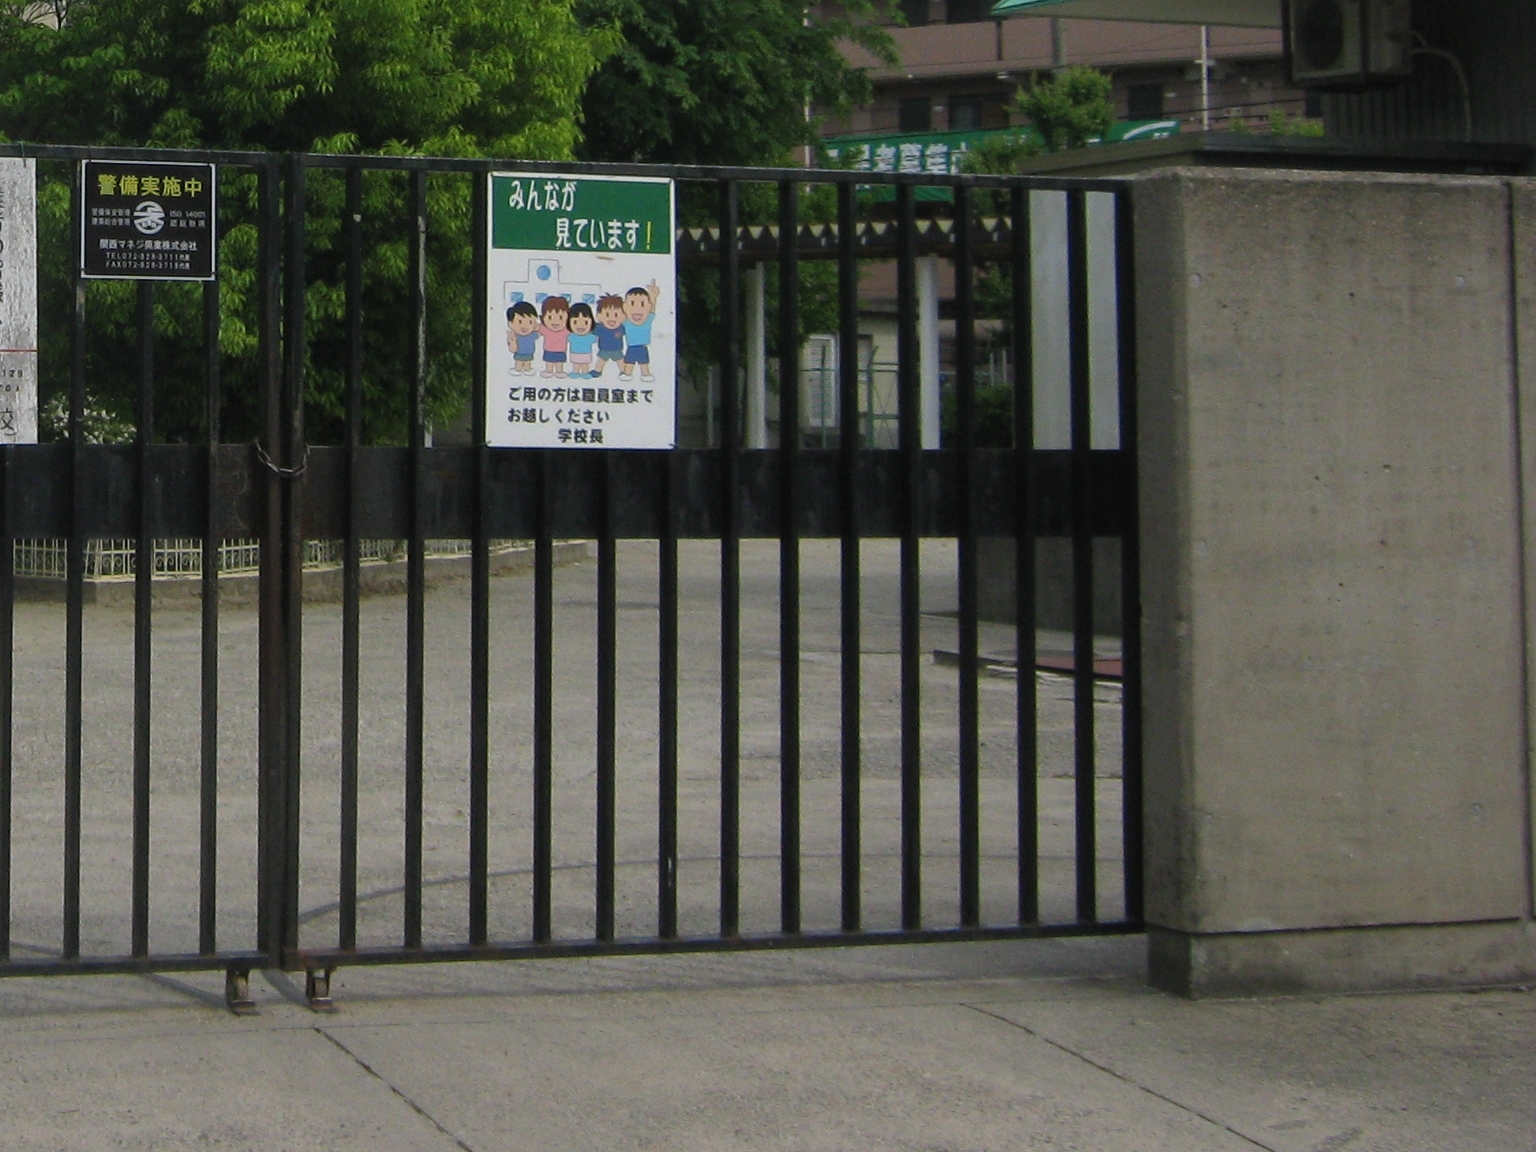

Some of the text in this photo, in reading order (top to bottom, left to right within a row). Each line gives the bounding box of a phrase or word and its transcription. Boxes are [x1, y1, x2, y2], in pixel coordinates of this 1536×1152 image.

[97, 173, 203, 198] 警備実施中
[509, 180, 578, 212] みんなが
[555, 218, 654, 250] 見ています！
[509, 386, 654, 404] ご用の方は職員室まで
[507, 408, 610, 425] お越しください
[558, 428, 605, 445] 学校長
